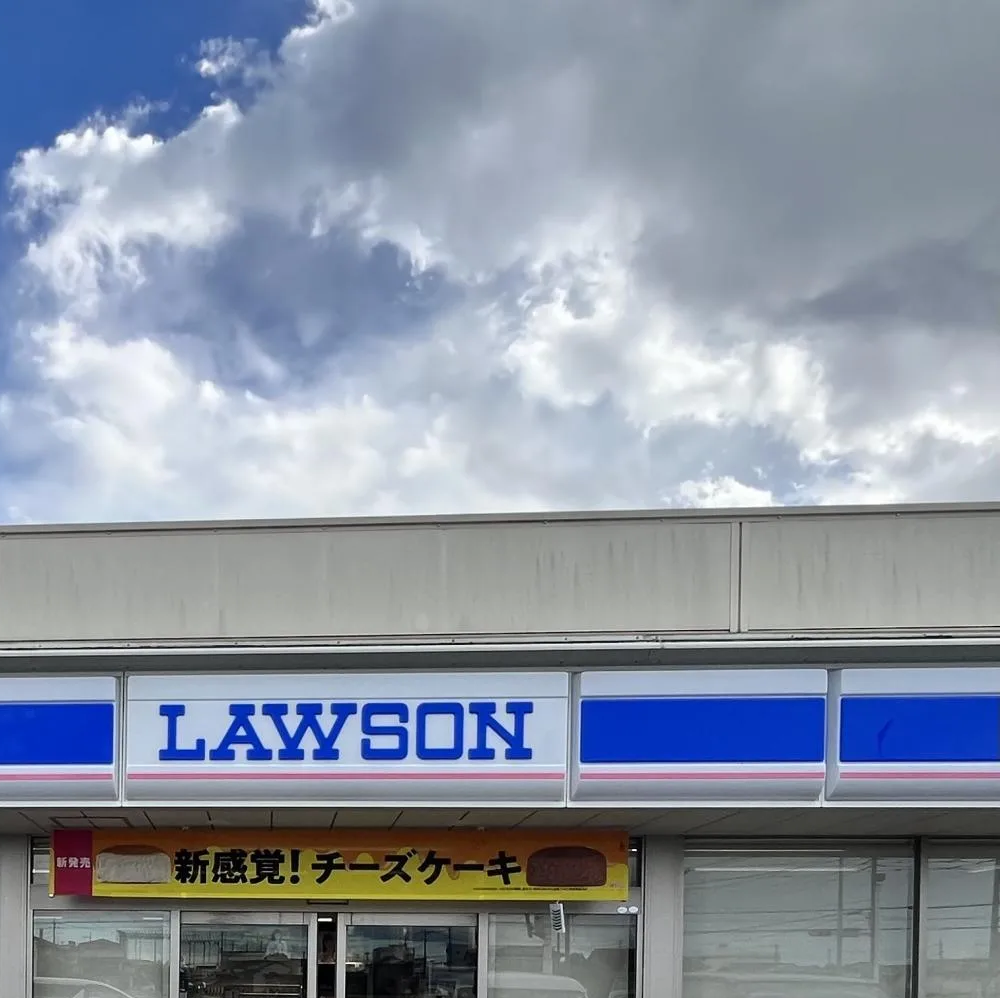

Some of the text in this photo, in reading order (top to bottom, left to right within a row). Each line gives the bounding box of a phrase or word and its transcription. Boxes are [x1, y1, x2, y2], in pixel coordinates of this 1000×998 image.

[159, 702, 533, 760] LAWSON
[56, 856, 92, 868] 新発売
